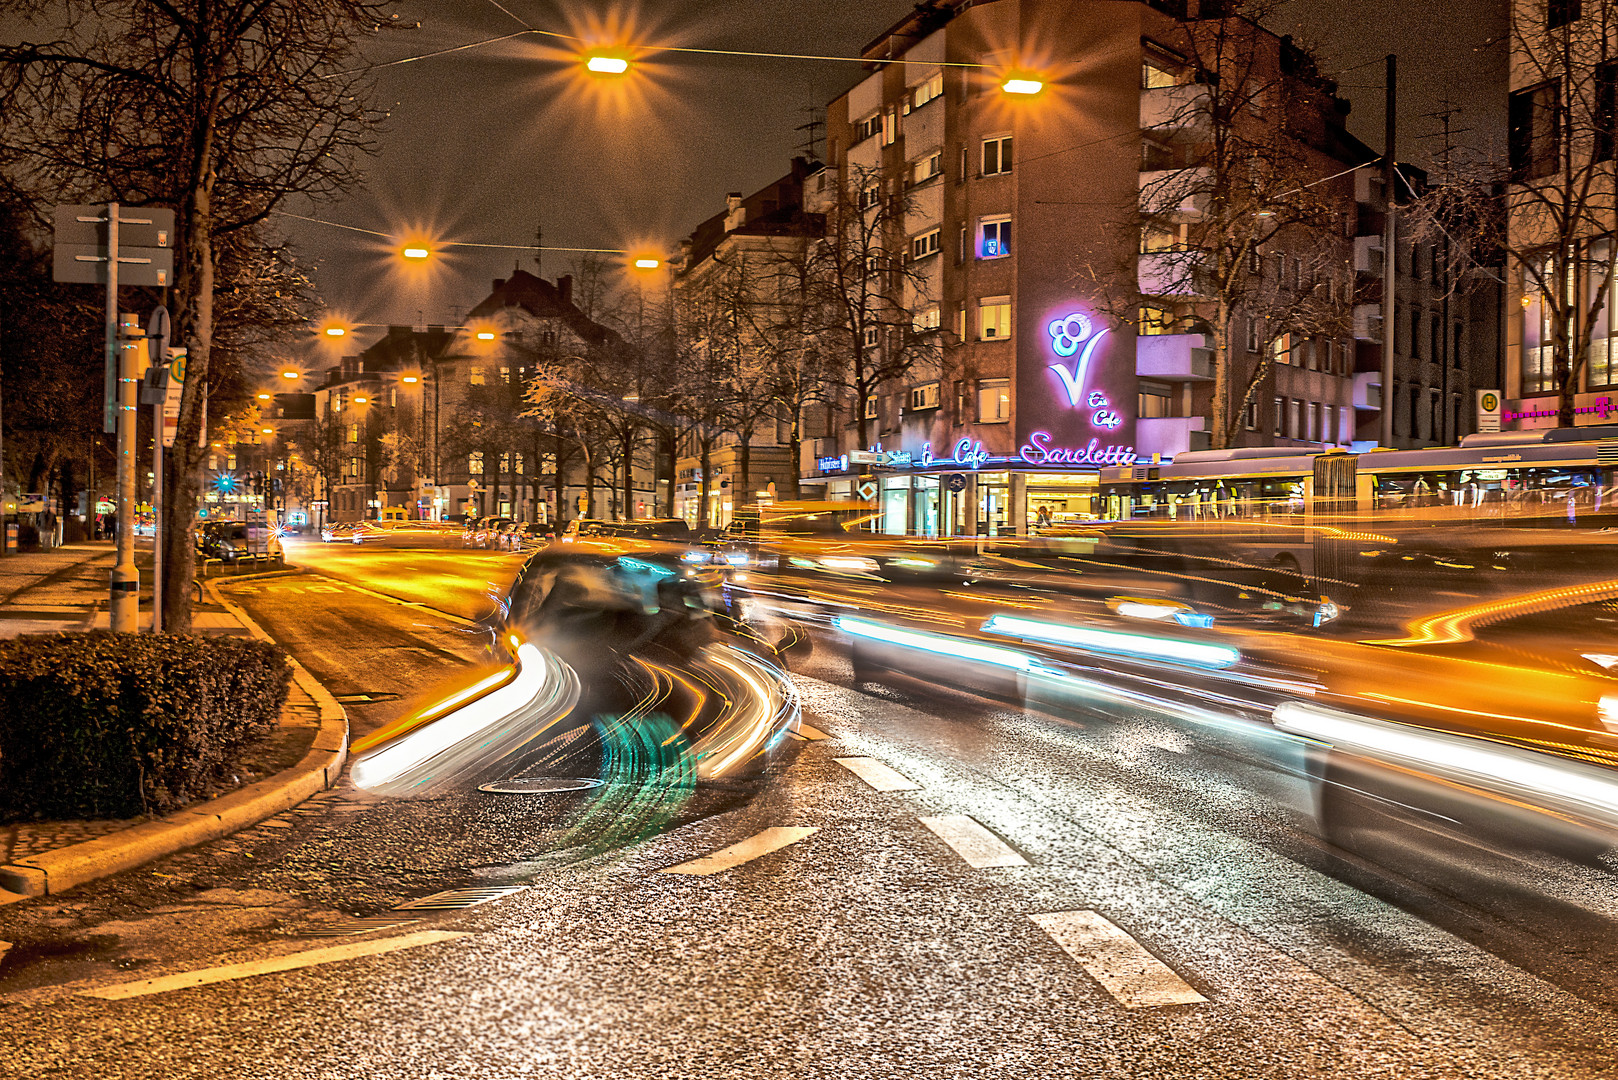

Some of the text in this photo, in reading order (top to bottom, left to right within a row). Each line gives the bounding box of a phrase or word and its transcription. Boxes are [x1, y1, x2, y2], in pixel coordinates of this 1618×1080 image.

[1088, 391, 1108, 408] Eis
[1486, 398, 1493, 408] H
[1595, 397, 1609, 418] T
[1093, 409, 1122, 429] Cafe
[953, 437, 988, 469] Cafe
[1019, 430, 1138, 465] Sarcletti
